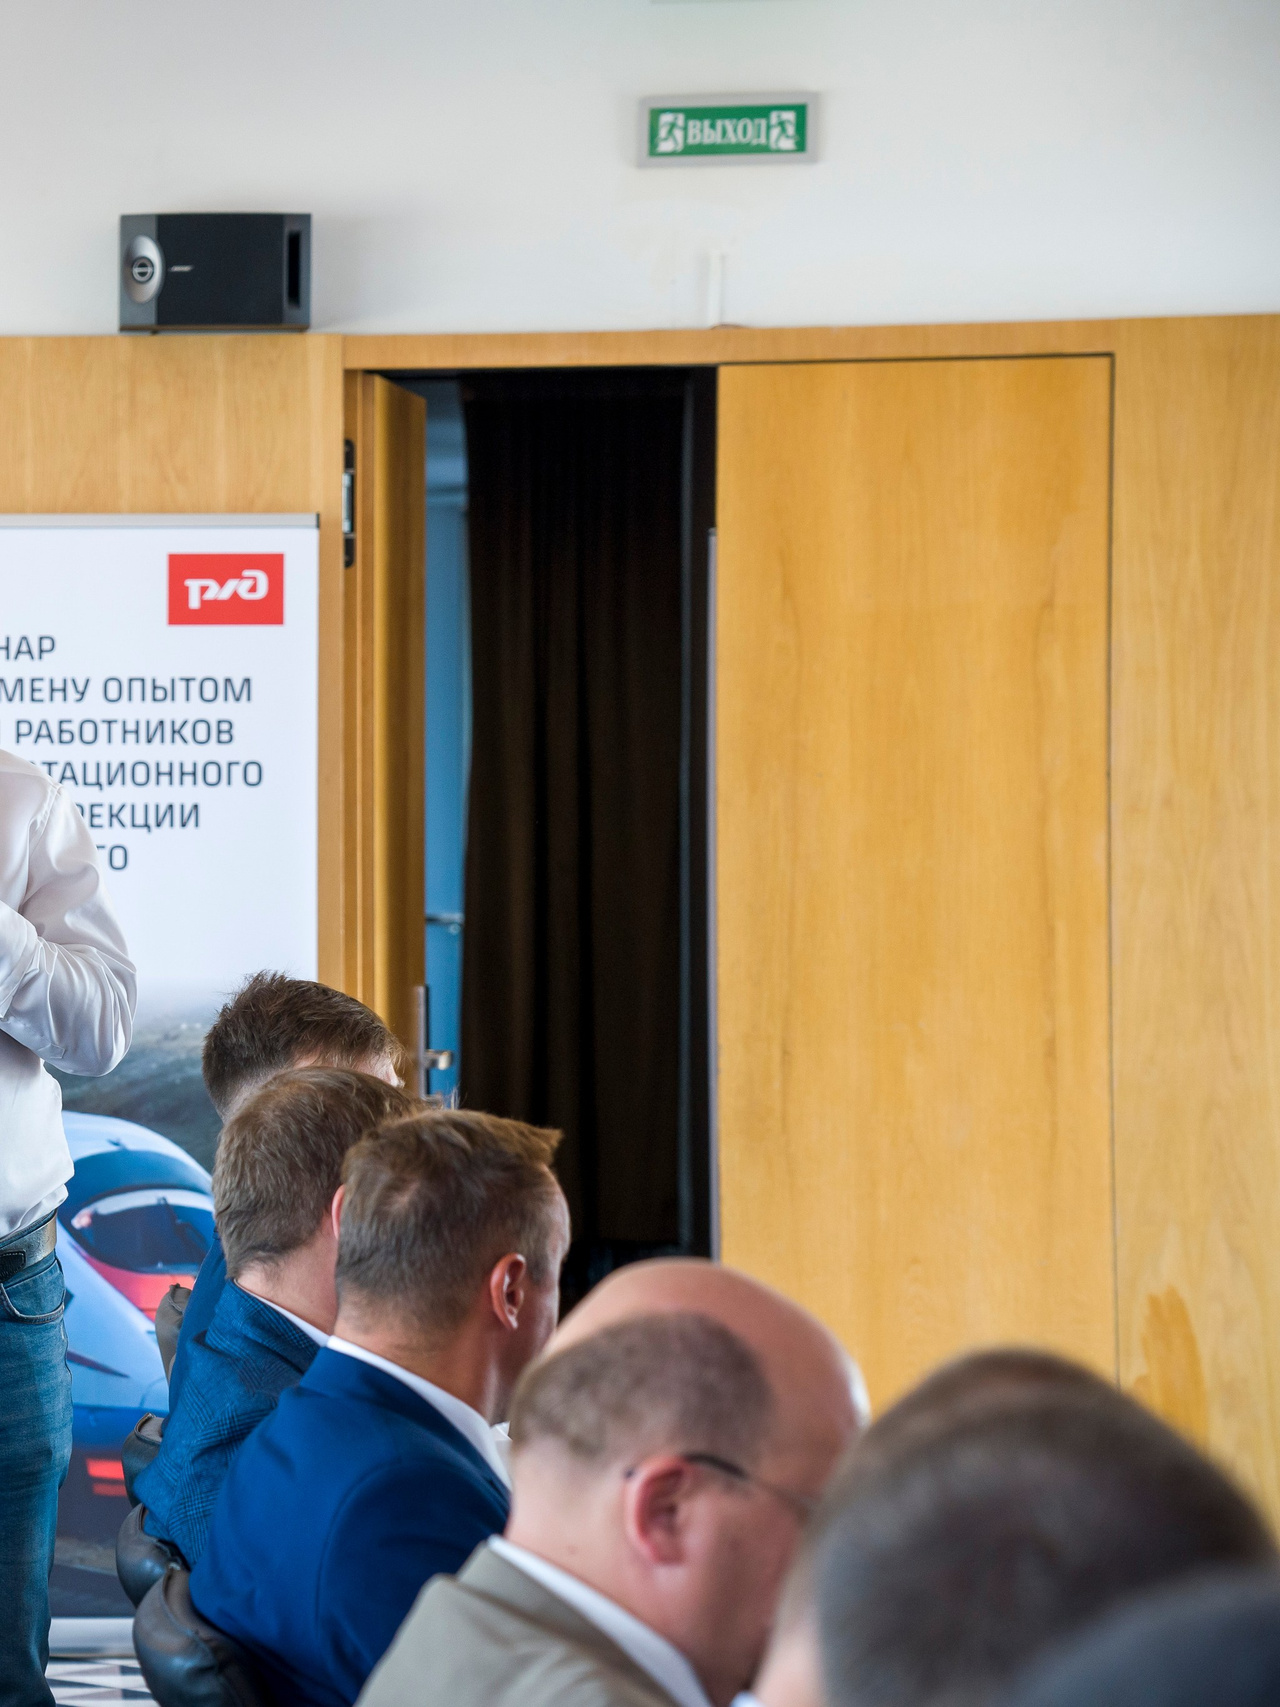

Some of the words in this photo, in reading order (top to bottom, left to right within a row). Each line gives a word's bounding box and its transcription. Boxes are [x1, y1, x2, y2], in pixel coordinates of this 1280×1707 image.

[686, 118, 768, 145] ВЫХОД
[103, 677, 252, 703] ОПЫТОМ
[15, 719, 234, 745] РАБОТНИКОВ
[32, 761, 264, 791] ТАЦИОННОГО
